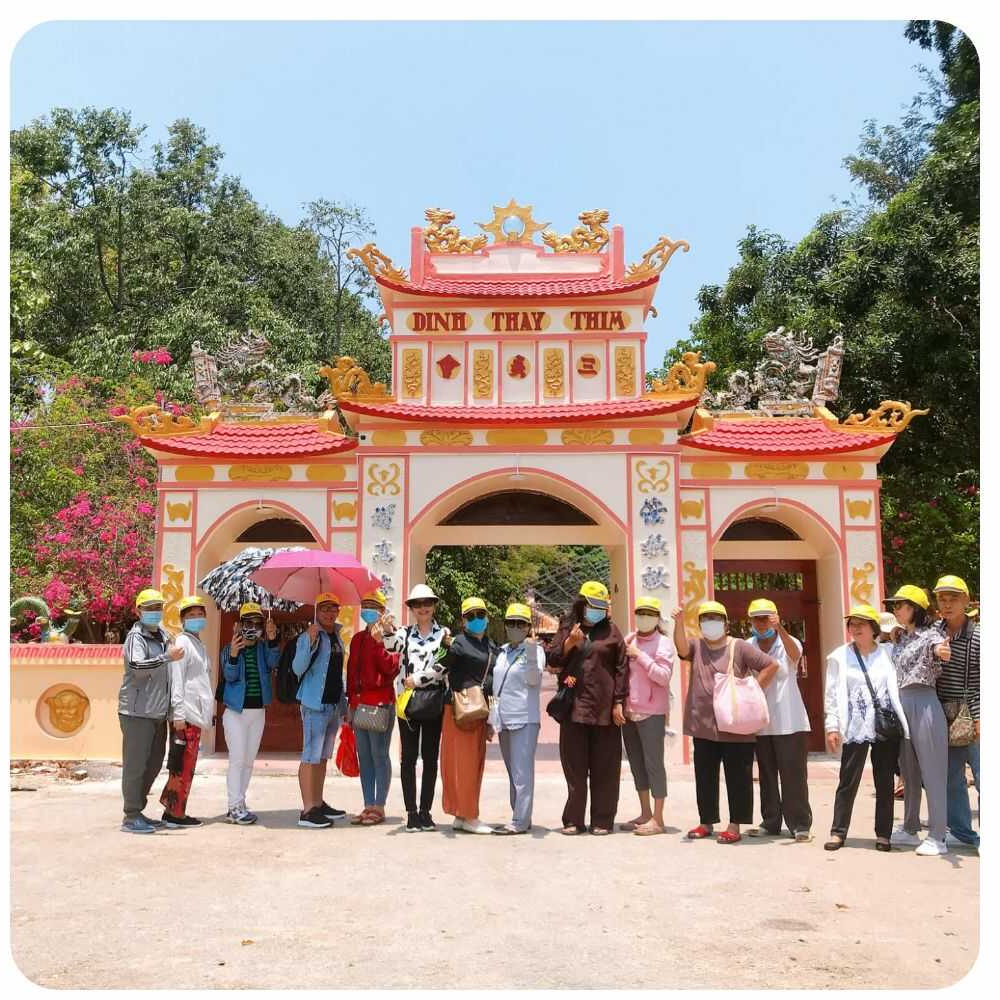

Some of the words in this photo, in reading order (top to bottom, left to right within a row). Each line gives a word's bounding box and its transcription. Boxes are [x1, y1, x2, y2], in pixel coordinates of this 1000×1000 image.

[412, 312, 467, 331] DINH
[491, 311, 546, 331] THAY
[570, 311, 626, 331] THIM
